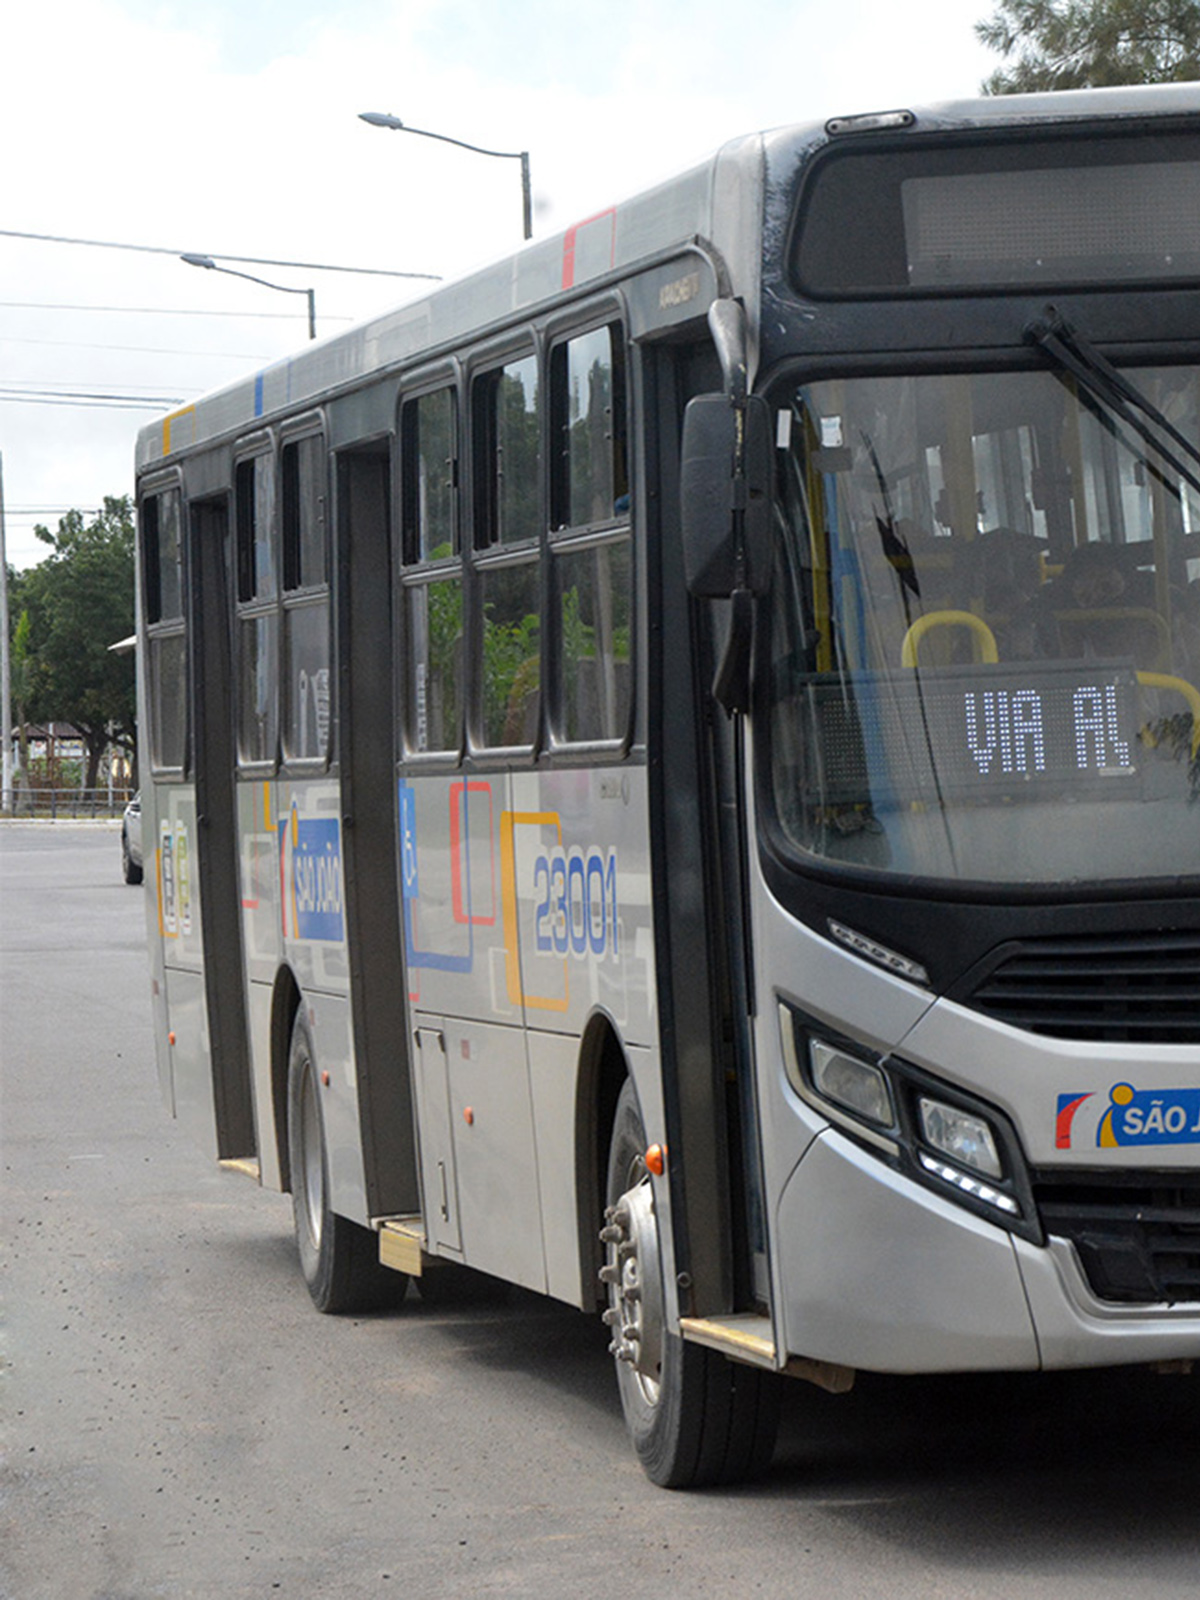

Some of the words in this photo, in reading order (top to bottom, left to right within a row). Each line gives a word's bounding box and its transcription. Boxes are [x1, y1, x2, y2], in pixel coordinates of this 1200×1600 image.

[965, 690, 1045, 773] VIA
[297, 842, 315, 913] SÃO
[534, 854, 618, 955] 23001
[1122, 1100, 1186, 1135] SÃO
